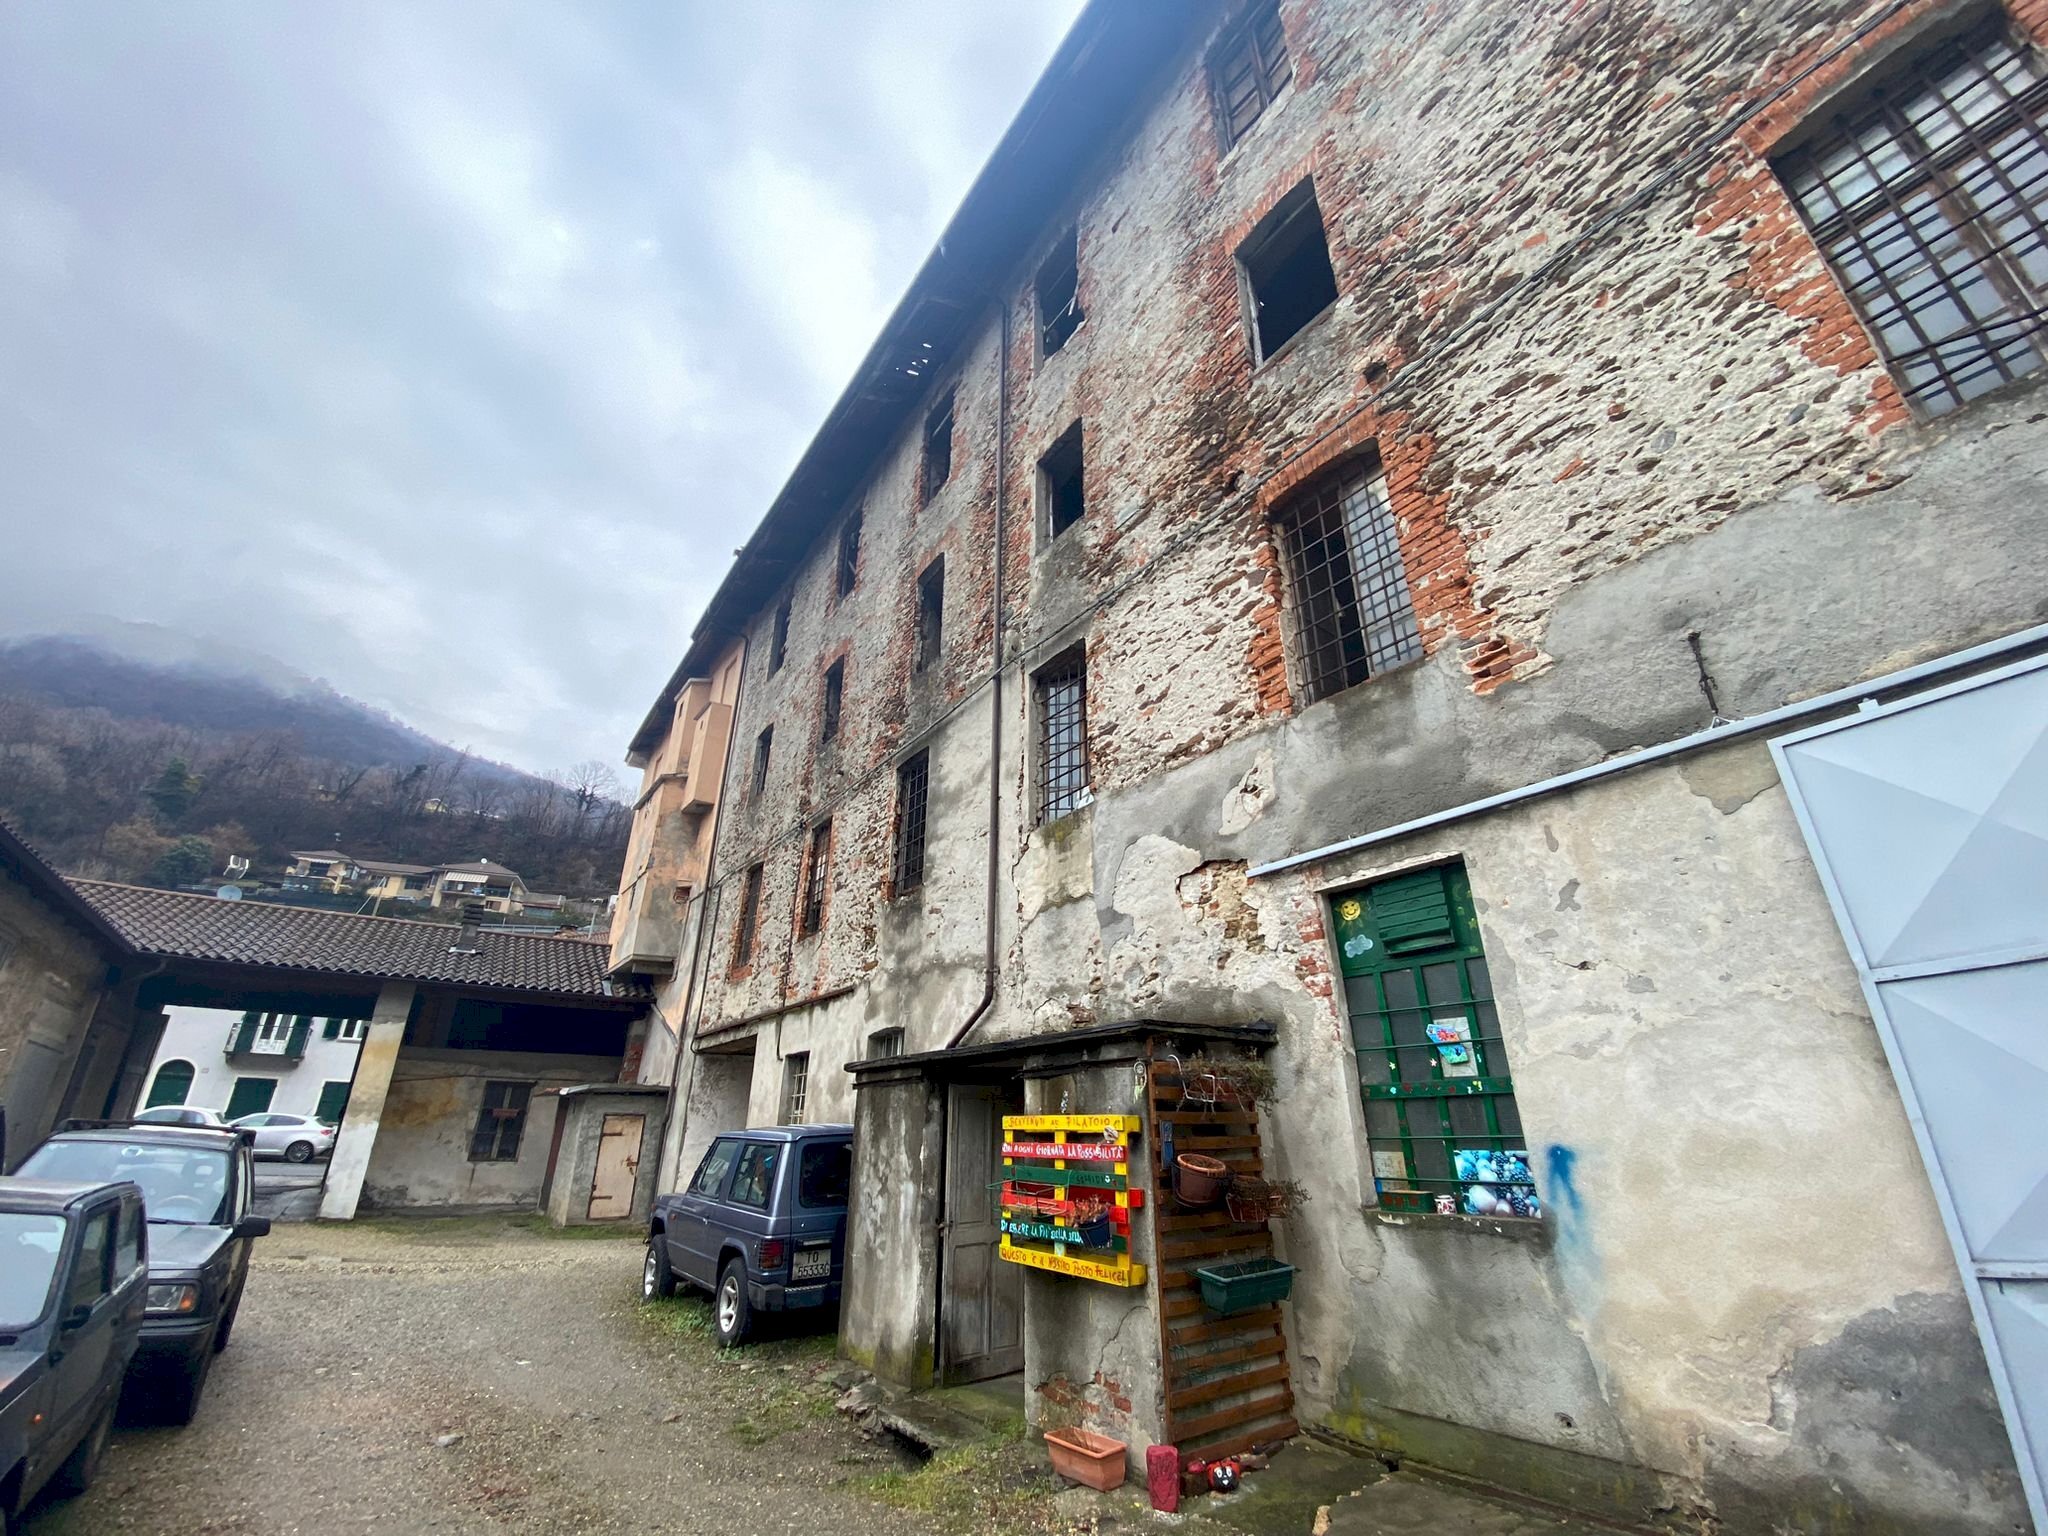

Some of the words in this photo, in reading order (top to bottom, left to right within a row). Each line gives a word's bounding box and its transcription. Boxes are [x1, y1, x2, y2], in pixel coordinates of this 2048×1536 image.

[1066, 1116, 1110, 1128] FILATOIO
[1018, 1143, 1033, 1154] OGNI
[1036, 1144, 1065, 1156] GIORNATA
[1067, 1145, 1076, 1157] LA
[1000, 1219, 1008, 1232] DI
[806, 1251, 819, 1264] TO
[1001, 1247, 1027, 1262] QUESTO
[1072, 1260, 1094, 1277] POSTO
